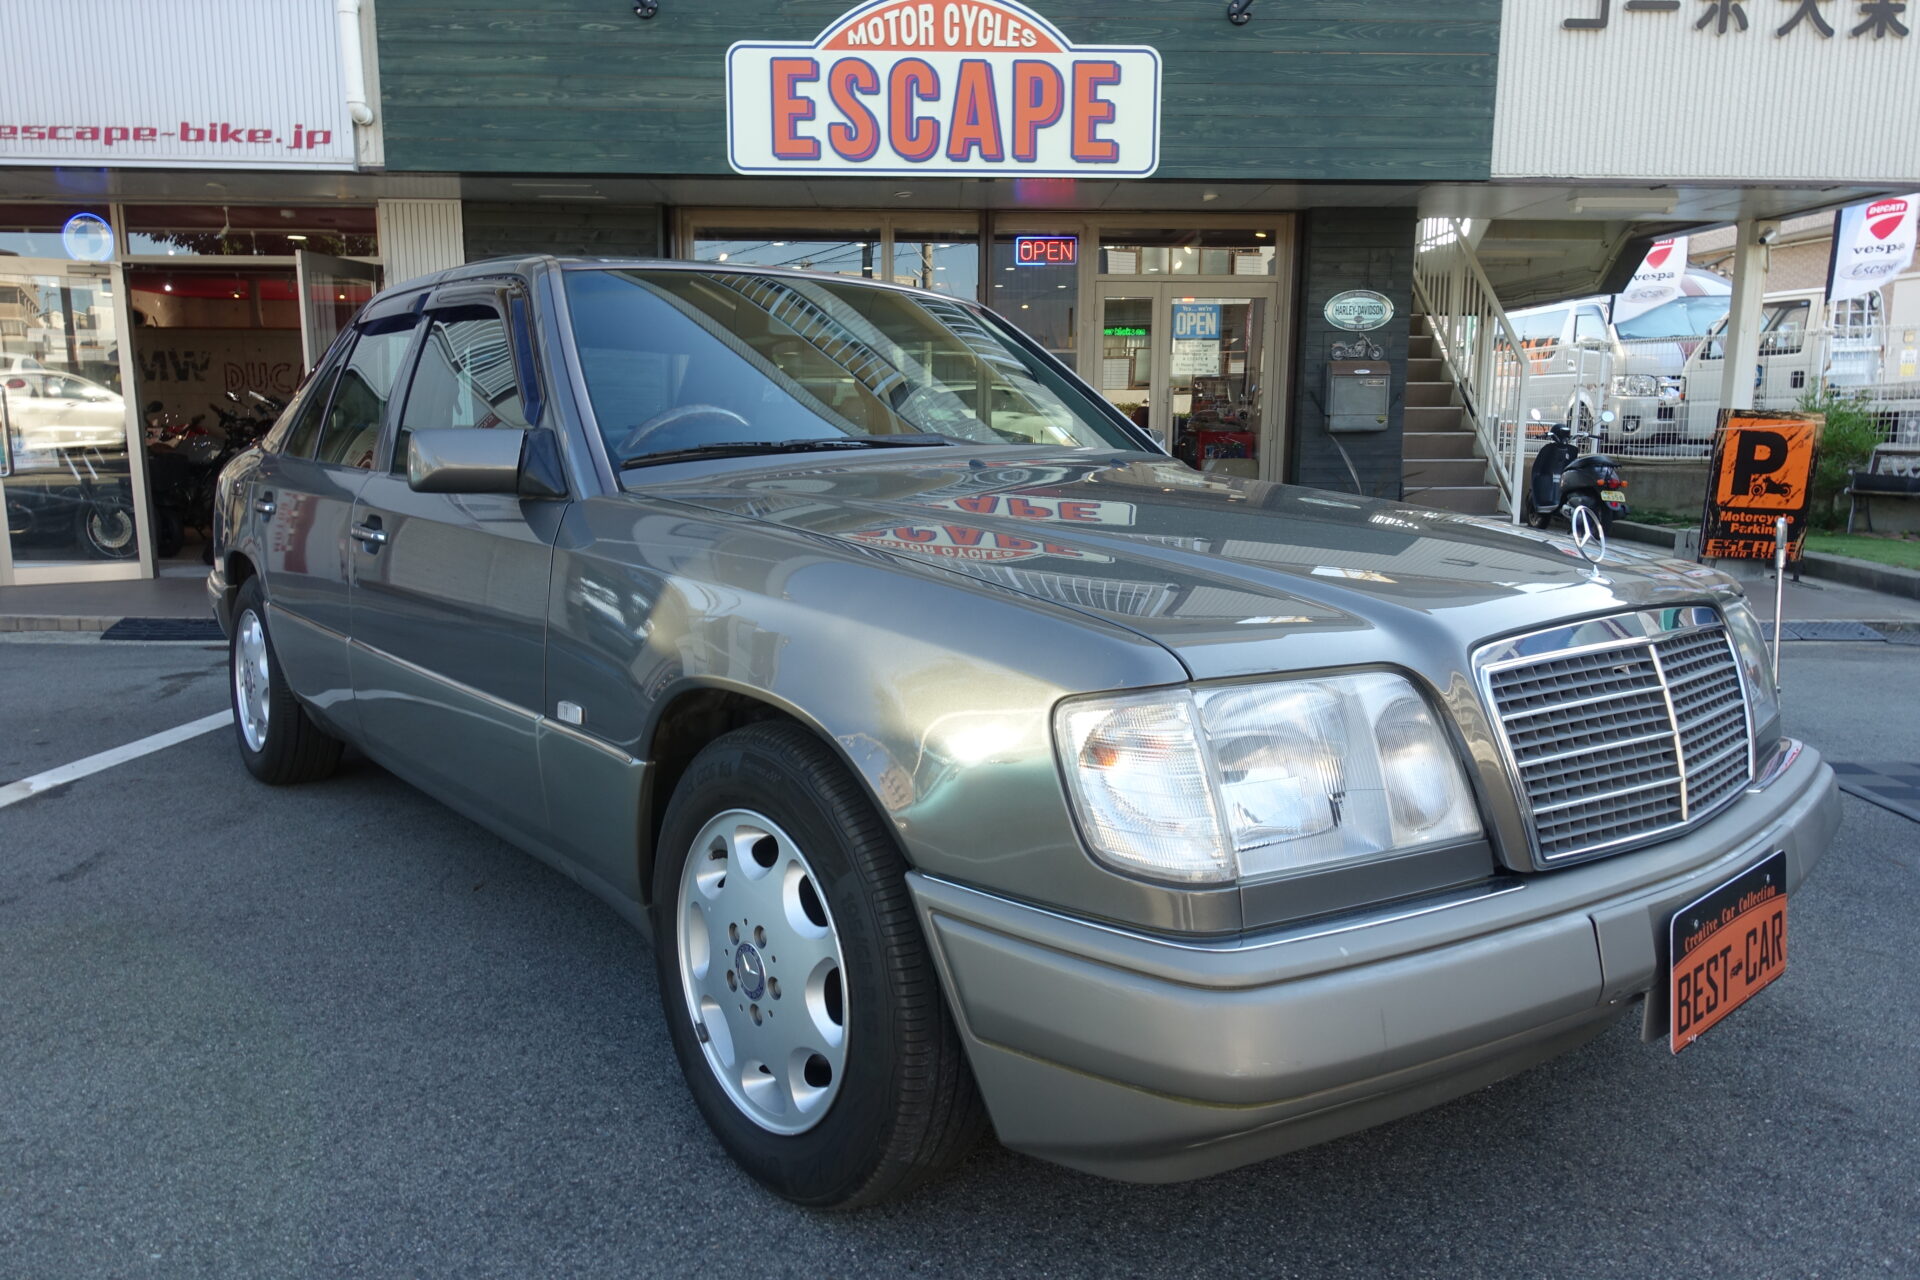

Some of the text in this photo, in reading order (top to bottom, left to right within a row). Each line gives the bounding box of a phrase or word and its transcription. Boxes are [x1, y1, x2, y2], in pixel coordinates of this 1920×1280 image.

[847, 3, 1038, 47] MOTOR CYCLES
[770, 57, 1122, 163] ESCAPE
[0, 122, 332, 149] escape-bike.jp
[1868, 202, 1906, 215] DUCATI
[1020, 240, 1073, 261] OPEN
[1633, 271, 1675, 281] vespa
[1176, 312, 1217, 335] OPEN
[1334, 304, 1384, 316] HARLEY-DAVIDSON
[138, 351, 211, 382] MW
[223, 361, 305, 395] DUC
[1731, 430, 1789, 496] P
[1684, 884, 1776, 953] Creative Car Collection
